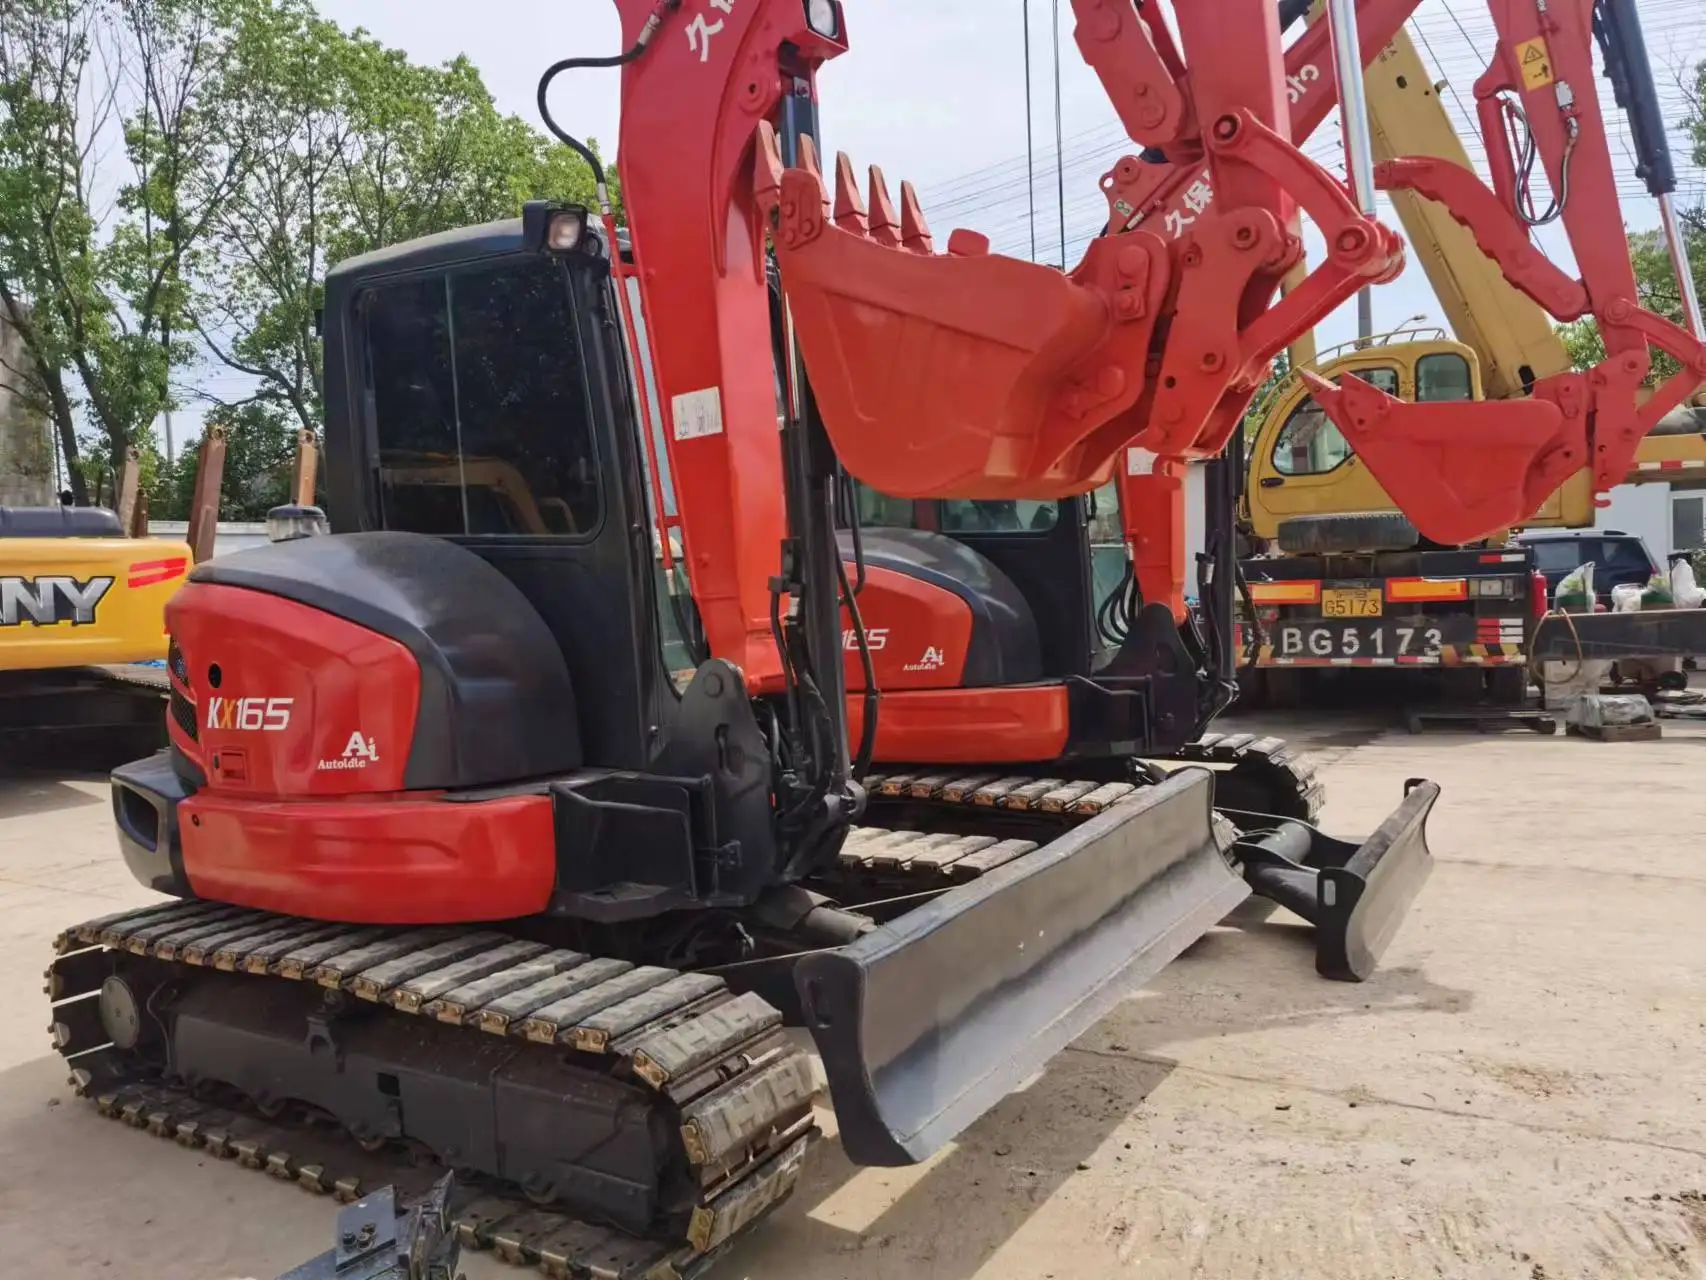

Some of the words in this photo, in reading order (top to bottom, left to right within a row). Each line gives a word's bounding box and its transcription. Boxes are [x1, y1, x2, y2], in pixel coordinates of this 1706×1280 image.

[1164, 168, 1213, 240] 久保
[0, 576, 116, 627] NY
[1324, 600, 1379, 615] G5173
[207, 696, 294, 730] KX165
[341, 730, 380, 761] Ai
